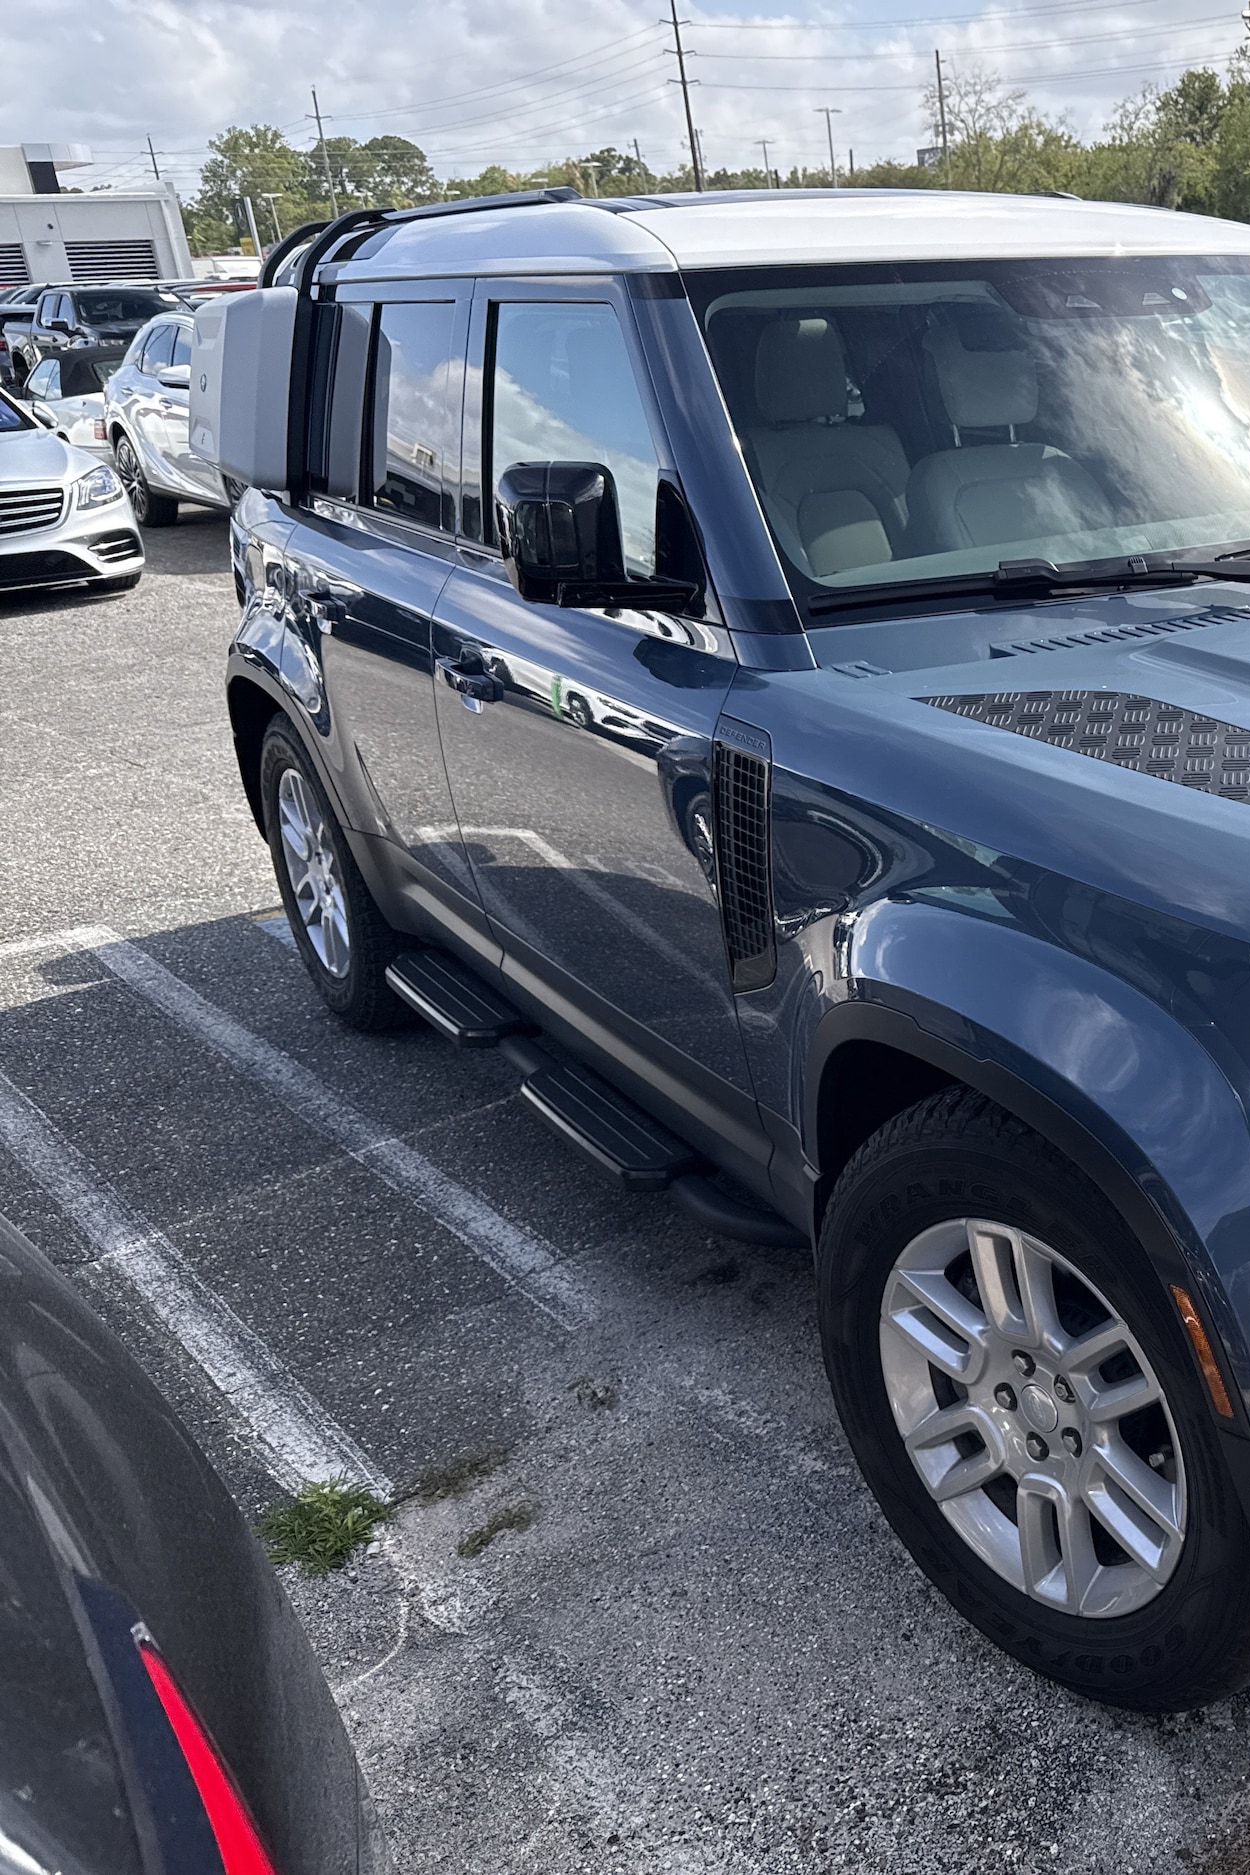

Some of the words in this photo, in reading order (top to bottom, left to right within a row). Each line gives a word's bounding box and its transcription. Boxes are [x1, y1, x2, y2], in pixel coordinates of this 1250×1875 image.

[718, 726, 767, 750] DEFENDER
[853, 1177, 1117, 1287] WRANGLER
[919, 1543, 1188, 1675] GOODYEAR
